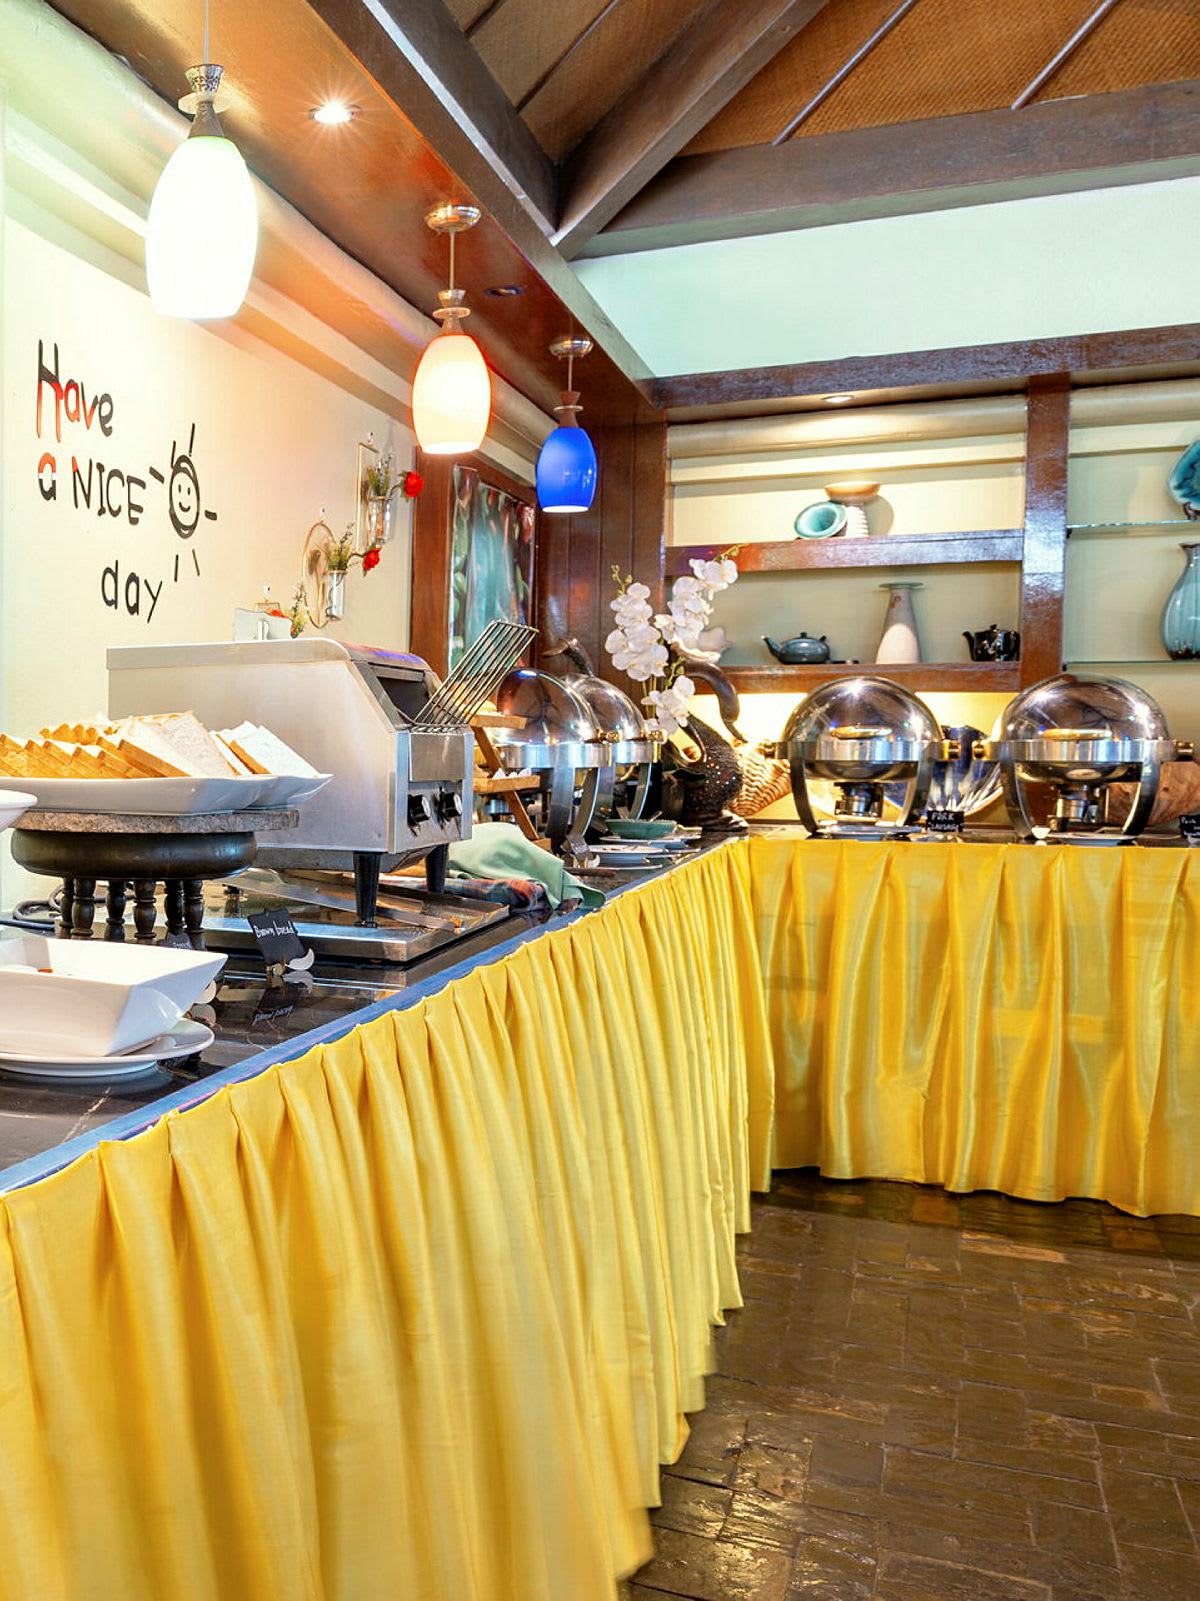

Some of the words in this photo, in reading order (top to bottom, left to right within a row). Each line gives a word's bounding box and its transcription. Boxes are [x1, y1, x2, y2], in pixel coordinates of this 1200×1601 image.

[36, 339, 113, 443] Have
[37, 452, 56, 501] a
[72, 455, 146, 525] NICE
[101, 560, 163, 624] day
